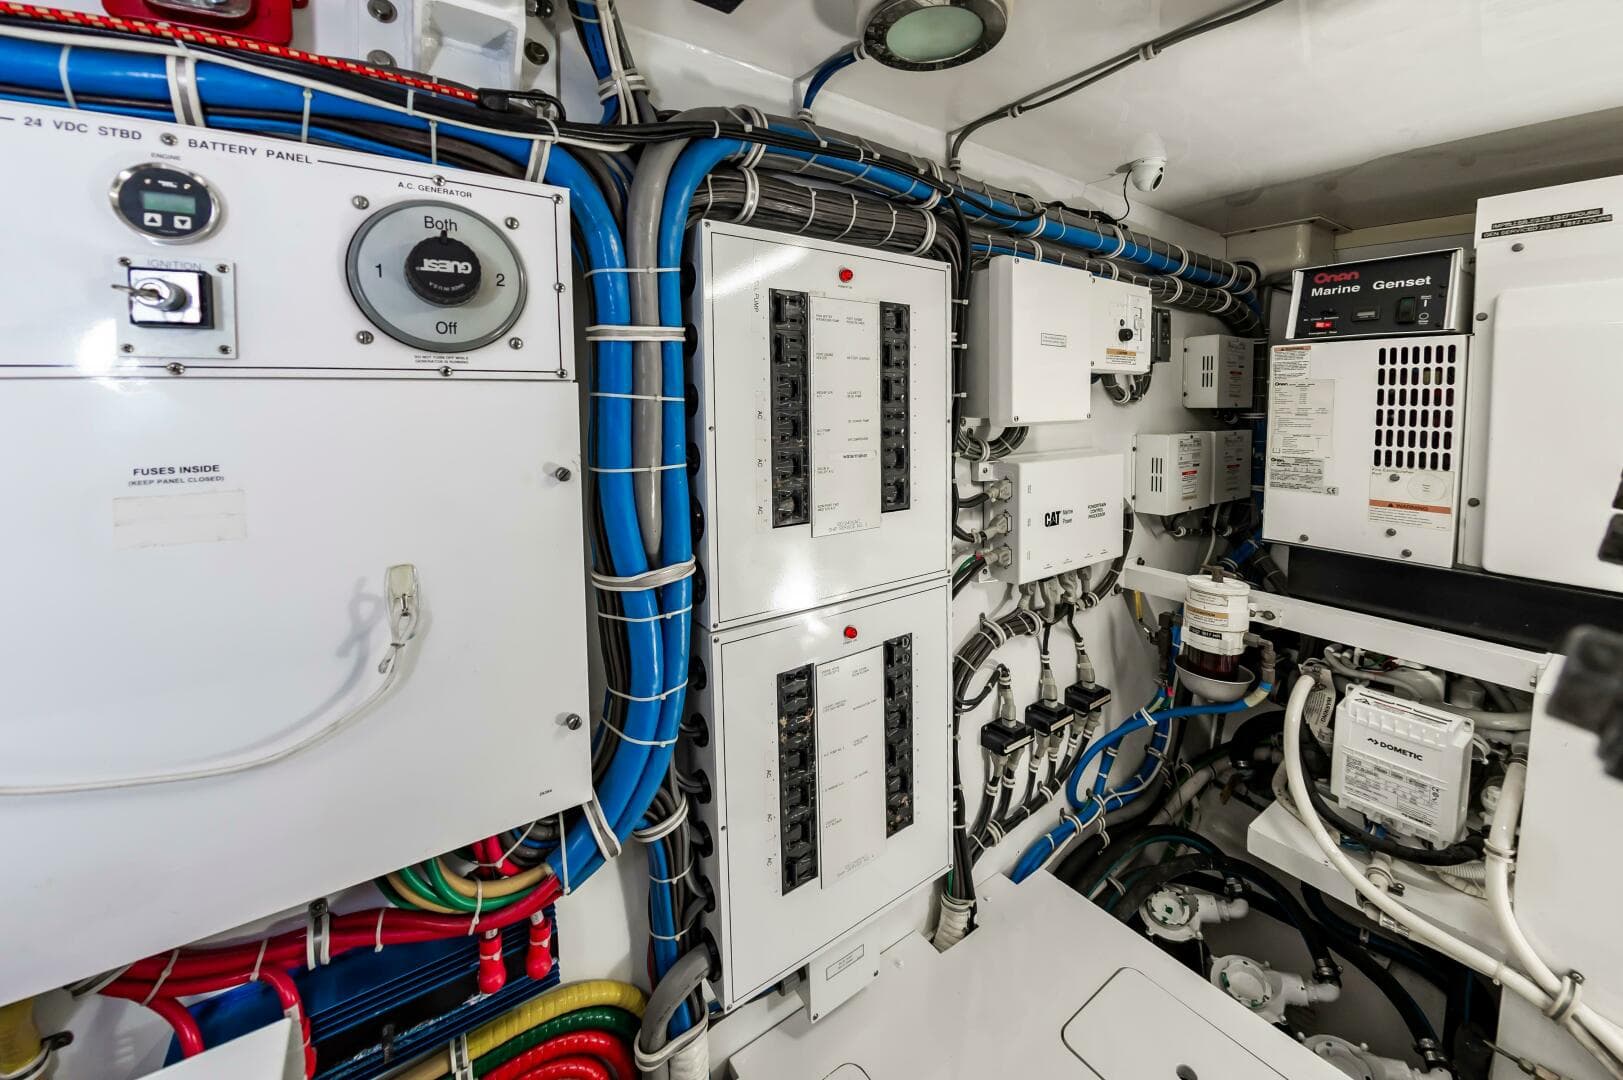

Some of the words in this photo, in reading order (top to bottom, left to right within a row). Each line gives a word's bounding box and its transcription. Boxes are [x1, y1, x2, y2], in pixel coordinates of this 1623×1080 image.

[24, 116, 42, 128] 24
[53, 120, 88, 134] VDC
[98, 126, 142, 140] STBD
[188, 138, 256, 156] BATTERY
[266, 150, 313, 164] PANEL
[151, 152, 180, 160] ENGINE
[398, 182, 416, 190] A.C.
[418, 184, 472, 198] GENERATOR
[424, 216, 458, 232] Both
[375, 264, 382, 278] 1
[421, 258, 472, 274] GUEST
[496, 274, 505, 286] 2
[1314, 271, 1360, 284] Onan
[1311, 284, 1360, 296] Marine
[1372, 276, 1432, 290] Genset
[436, 321, 458, 334] Off
[132, 466, 176, 476] FUSES
[179, 464, 220, 474] INSIDE
[128, 479, 154, 487] (KEEP
[187, 475, 224, 483] CLOSED)
[1045, 511, 1061, 527] CAT
[1380, 742, 1423, 761] DOMETIC
